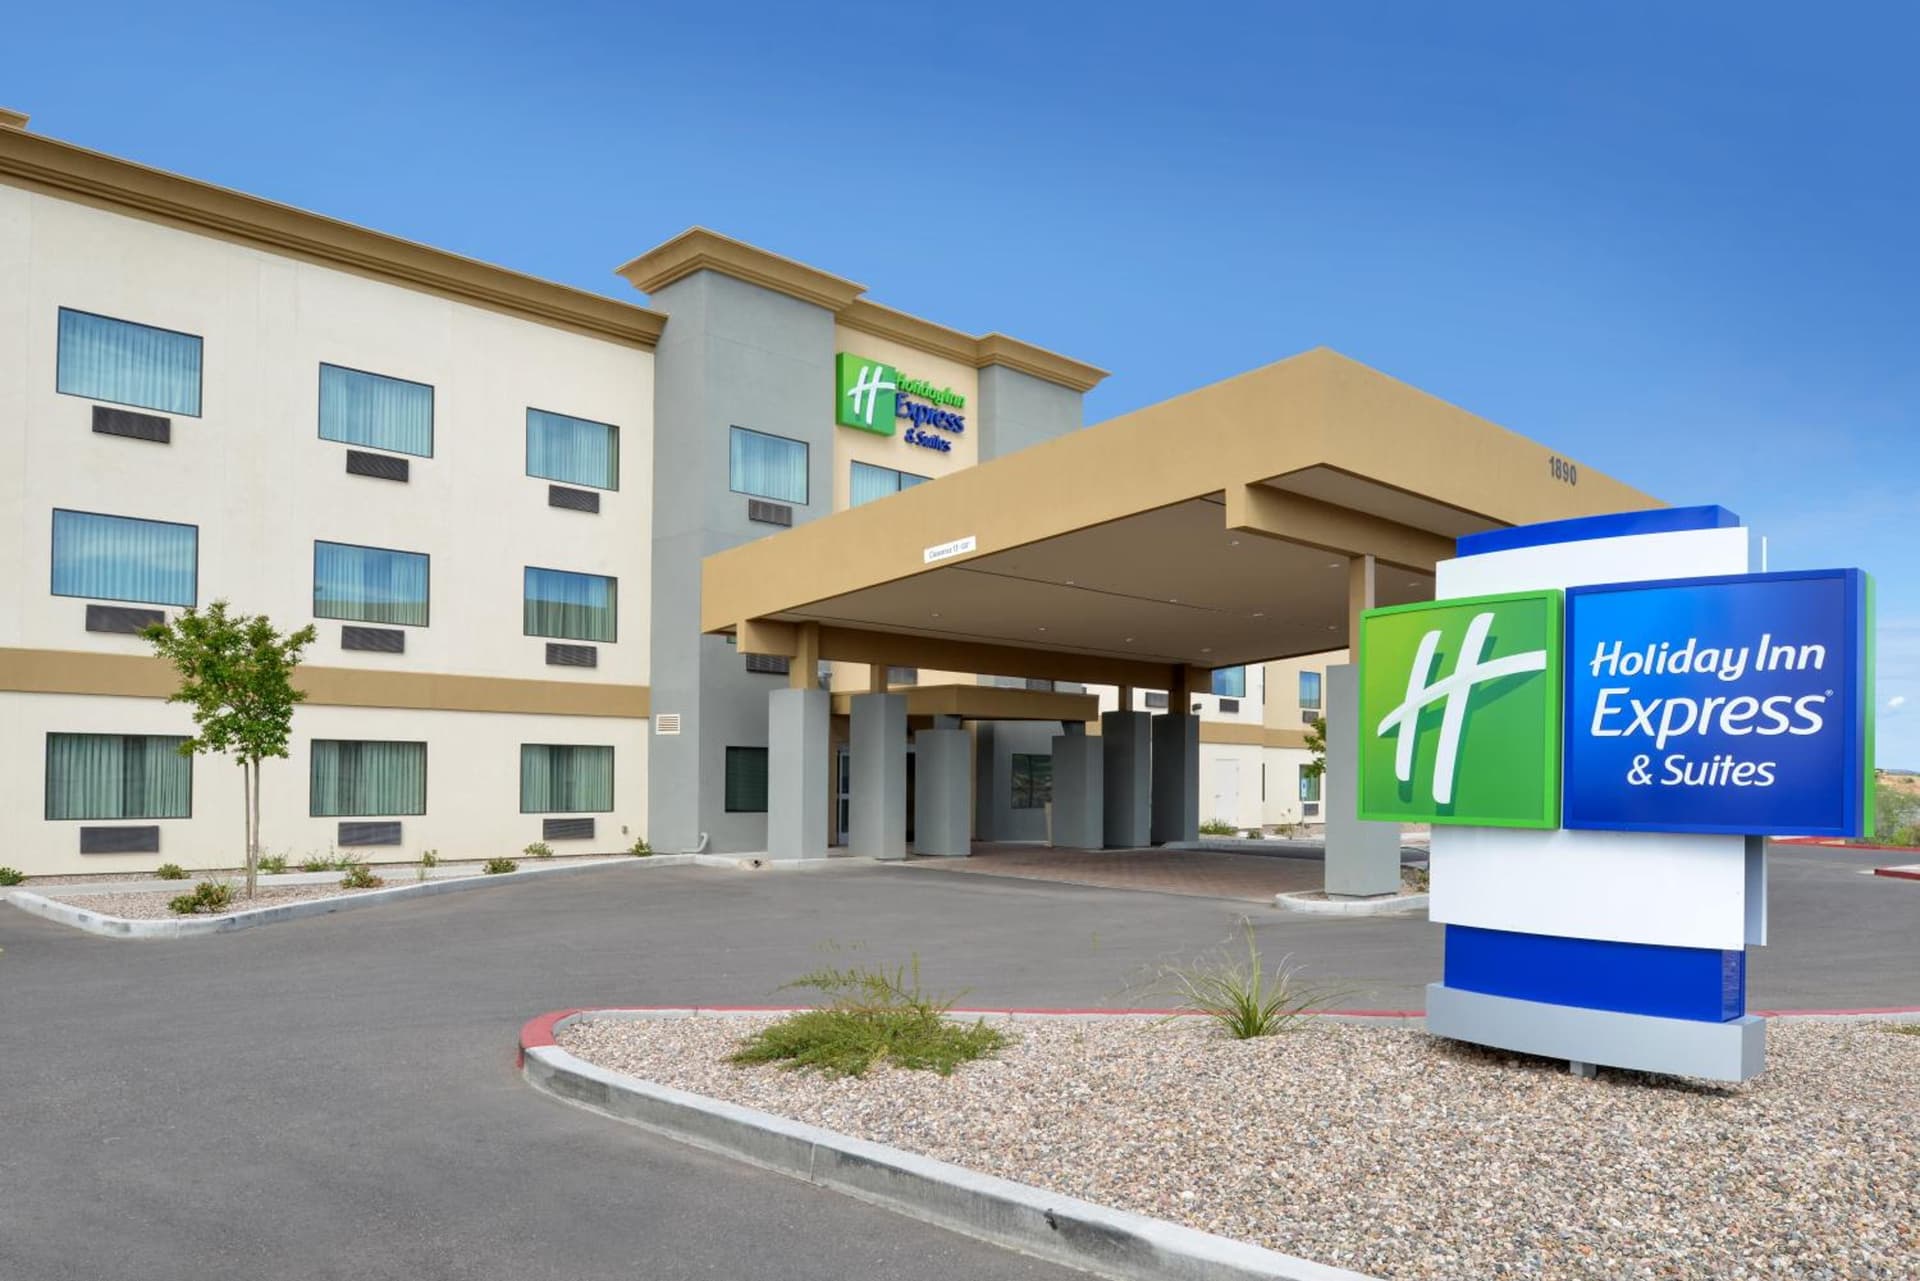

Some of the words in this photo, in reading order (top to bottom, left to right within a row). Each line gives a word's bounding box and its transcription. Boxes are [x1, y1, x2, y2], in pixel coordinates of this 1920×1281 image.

[896, 372, 943, 406] Holiday
[896, 393, 965, 433] Express
[904, 428, 916, 444] &
[915, 431, 951, 452] Suites
[1549, 455, 1577, 487] 1890
[1589, 637, 1750, 682] Holiday
[1755, 633, 1826, 672] Inn
[1377, 612, 1547, 805] H
[1627, 754, 1653, 786] &
[1660, 754, 1777, 787] Suites
